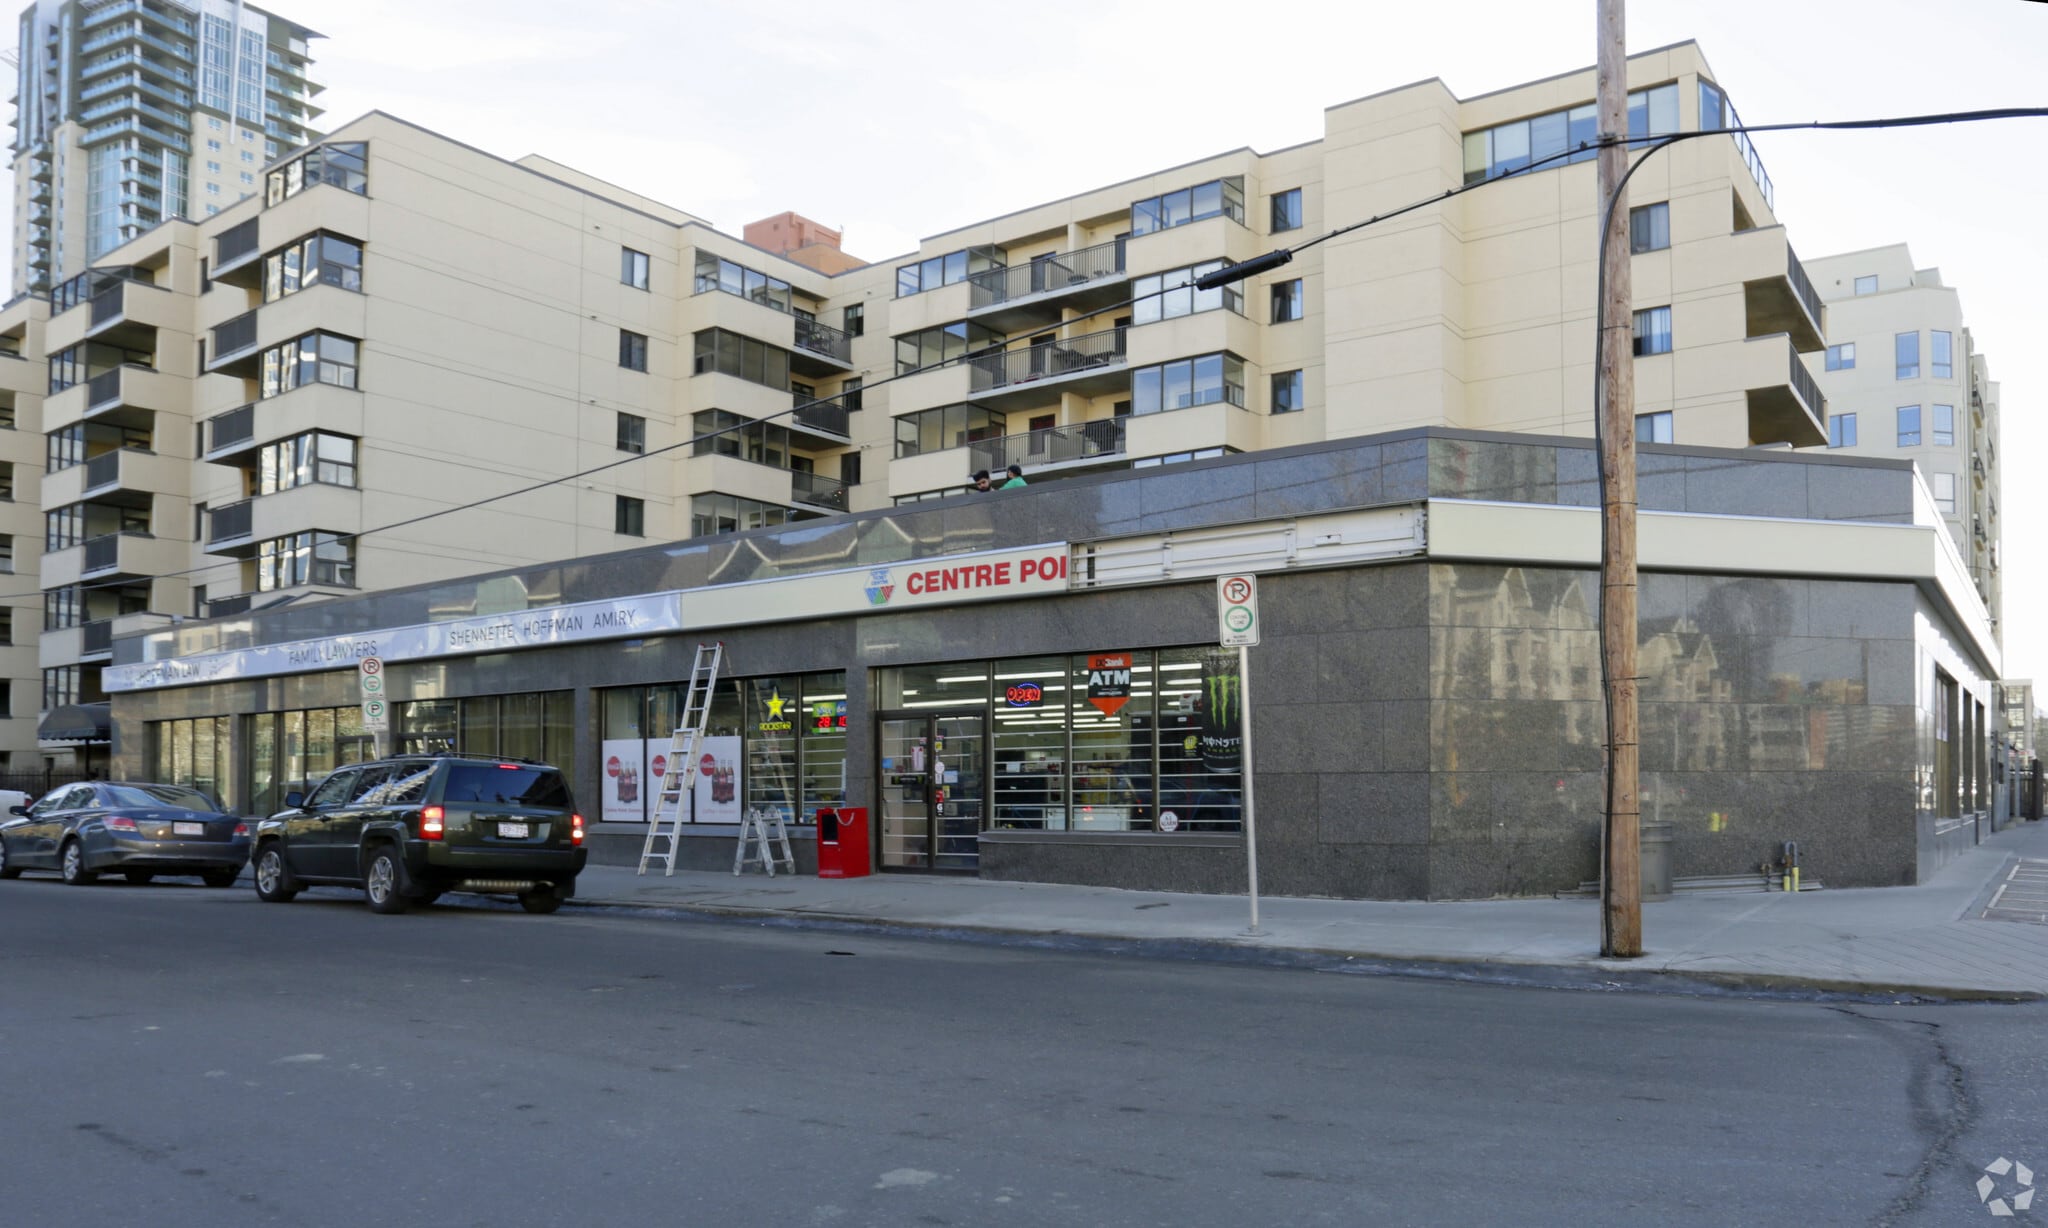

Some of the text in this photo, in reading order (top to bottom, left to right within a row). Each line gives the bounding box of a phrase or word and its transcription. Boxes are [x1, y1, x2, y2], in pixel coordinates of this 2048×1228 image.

[906, 561, 1011, 595] CENTRE
[450, 608, 637, 646] SHENNETTE HOFFMAN AMIRY
[288, 640, 377, 665] FAMILY LAWYERS
[181, 662, 200, 678] LAW
[1088, 669, 1131, 686] ATM
[1006, 687, 1042, 702] OPEN
